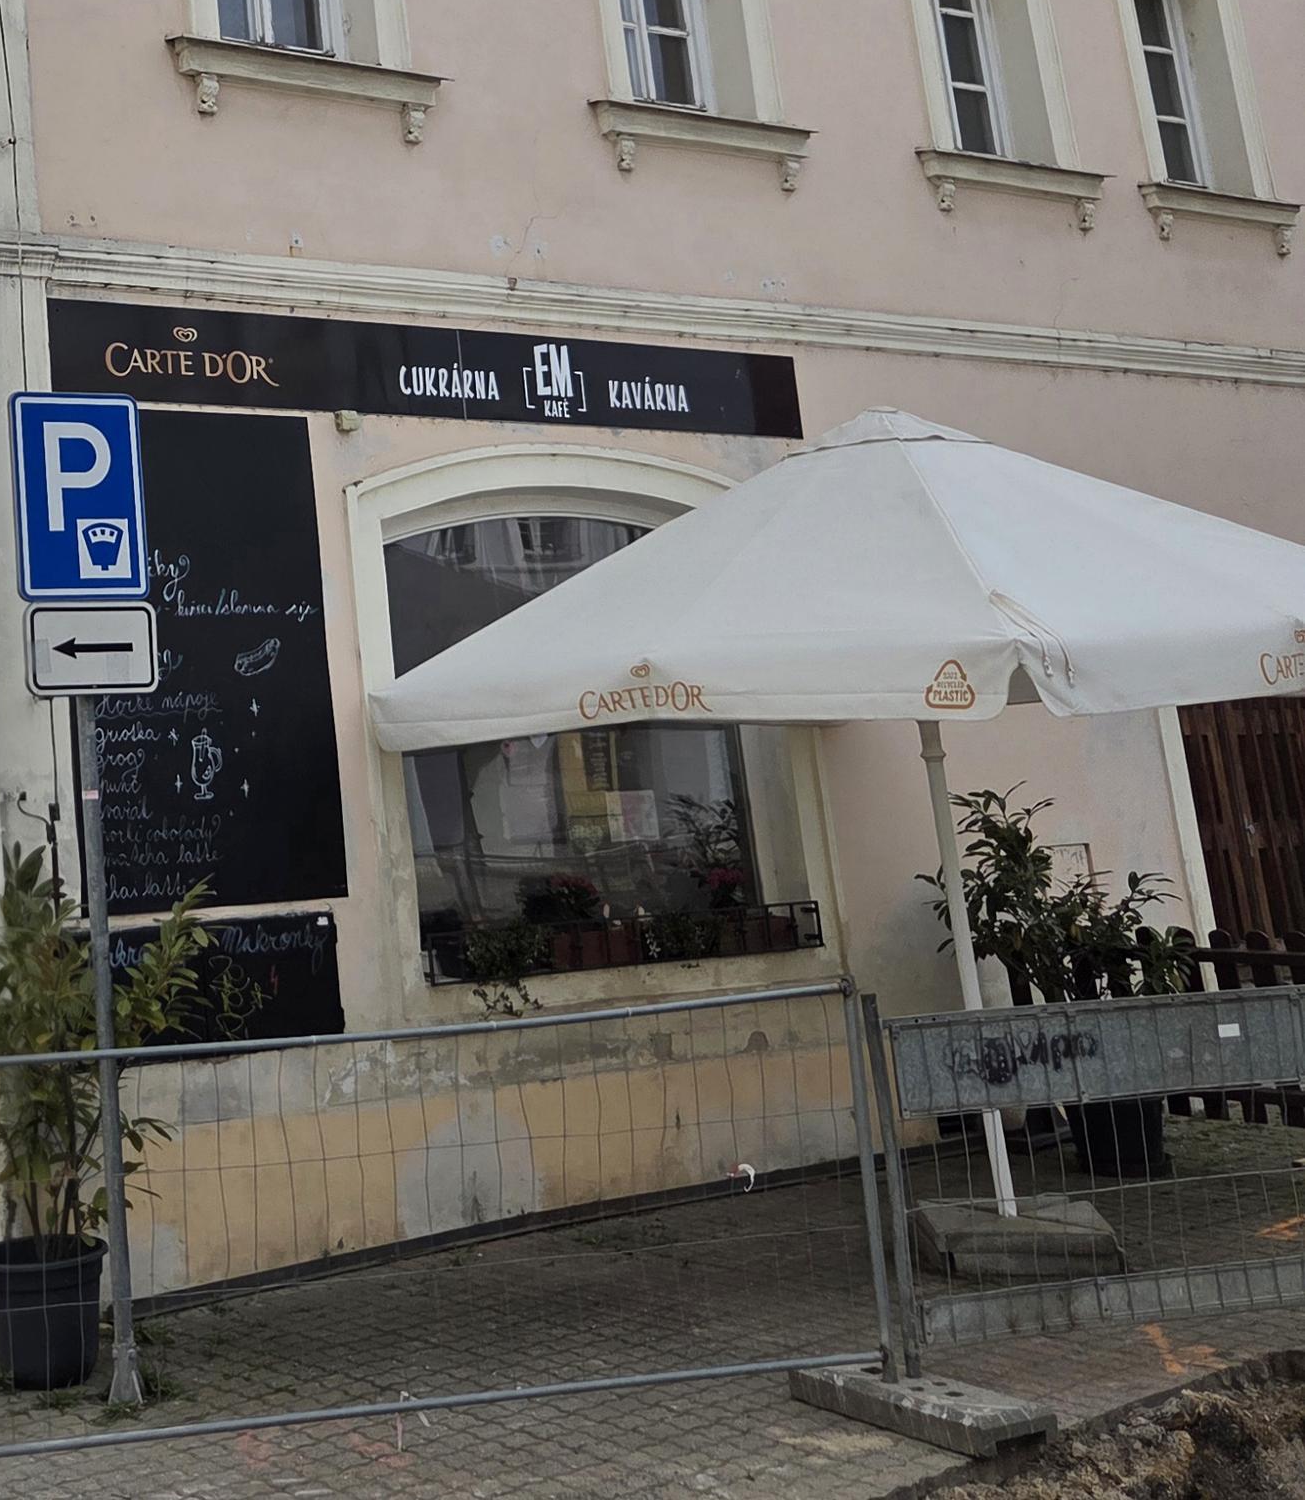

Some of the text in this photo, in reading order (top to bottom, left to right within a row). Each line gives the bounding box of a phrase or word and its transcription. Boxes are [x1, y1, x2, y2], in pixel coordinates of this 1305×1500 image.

[104, 342, 196, 378] CARTE
[533, 343, 574, 398] EM
[398, 362, 500, 401] CUKRÁRNA
[607, 376, 689, 413] KAVÁRNA
[543, 398, 571, 419] KAFÉ
[42, 420, 112, 532] P
[579, 685, 652, 720] CARTE
[933, 689, 970, 702] PLASTIC
[96, 748, 146, 782] grog
[222, 923, 328, 976] Makronky
